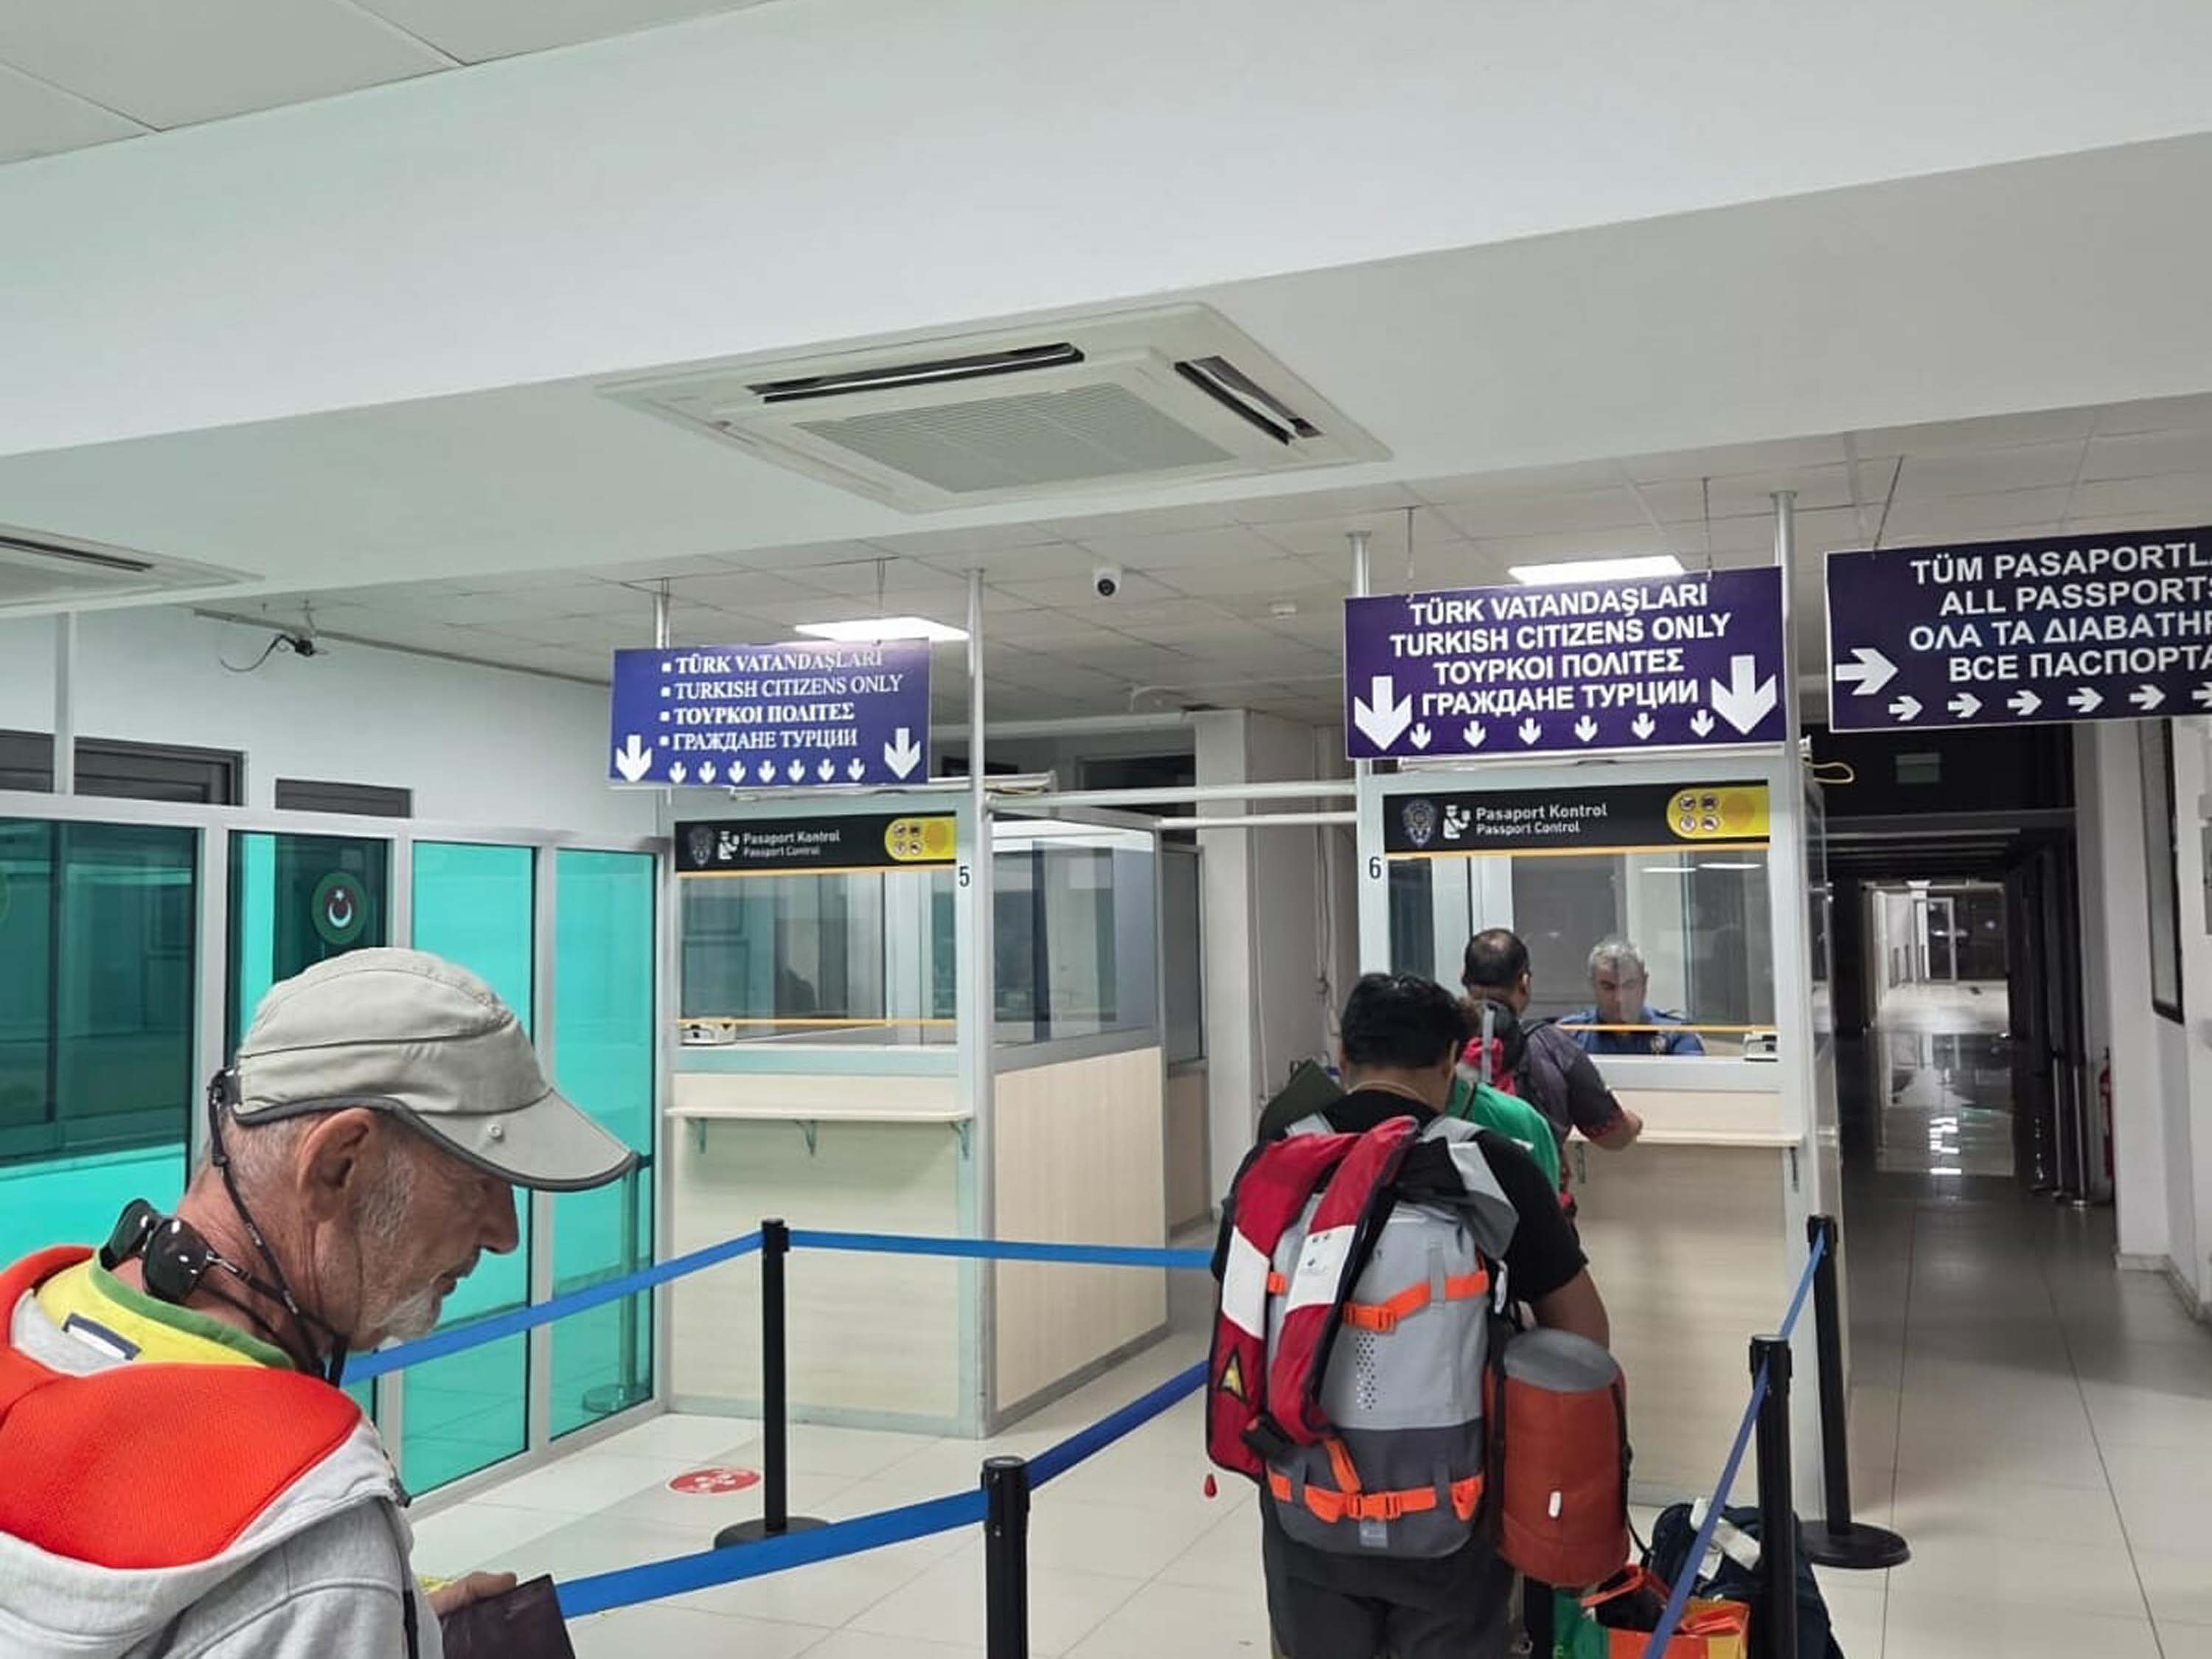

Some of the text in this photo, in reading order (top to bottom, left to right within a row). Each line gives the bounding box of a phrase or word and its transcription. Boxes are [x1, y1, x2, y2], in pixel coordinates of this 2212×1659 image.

[1910, 542, 2212, 585] TÜM PASAPORTL
[1409, 582, 1708, 626] TÜRK VATANDAŞLARI
[1939, 576, 2212, 616] ALL PASSPORT
[1389, 613, 1733, 658] TURKISH CITIZENS ONLY
[1908, 625, 1983, 652] ΟΛΑ
[1992, 619, 2036, 647] ΤΑ
[675, 653, 732, 674] TÜRK
[1433, 647, 1685, 686] ΤΟΥΡΚΟΙ ΠΟΛΙΤΕΣ
[1949, 654, 2020, 683] ВСЕ
[674, 673, 903, 700] TURKISH CITIZENS ONLY
[1422, 678, 1698, 718] ГРАЖДАНЕ ТУРЦИИ
[672, 702, 855, 725] ΤΟΥΡΚΟΙ ΠΟΛΙΤΕΣ
[672, 727, 858, 752] ГРАЖДАНЕ ТУРЦИИ
[1476, 803, 1608, 824] Pasaport Kontrol
[742, 829, 841, 846] Pasaport Kontrol
[1476, 819, 1581, 837] Passport Control
[959, 866, 970, 887] 5
[1369, 857, 1381, 880] 6
